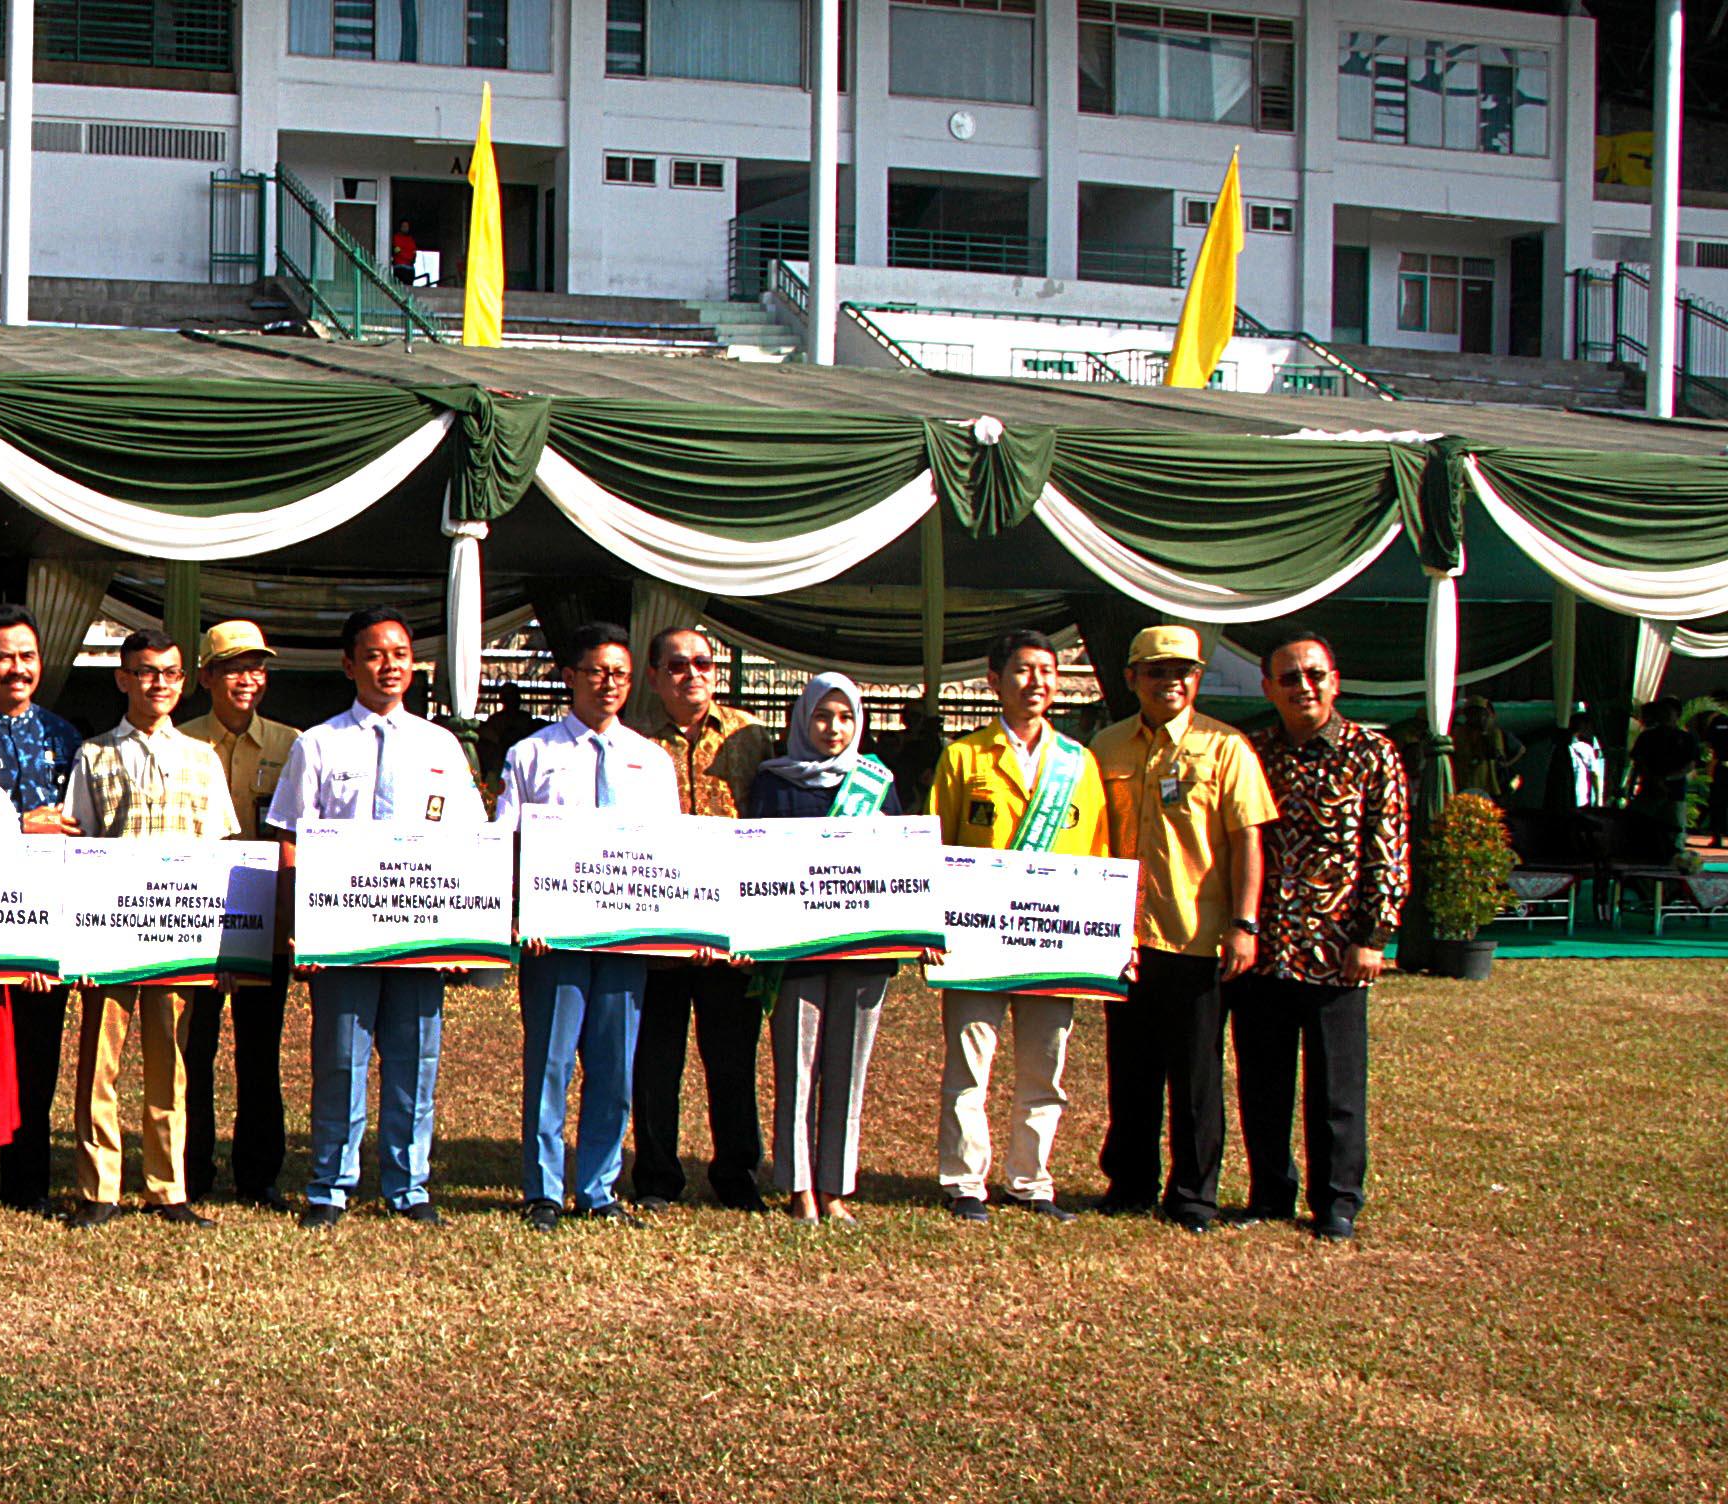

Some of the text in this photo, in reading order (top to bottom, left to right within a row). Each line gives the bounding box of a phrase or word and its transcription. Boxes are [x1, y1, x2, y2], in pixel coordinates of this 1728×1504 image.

[602, 850, 653, 861] BANTUAN
[379, 862, 432, 871] BANTUAN
[574, 861, 681, 879] BEASISWA PRESTASI
[808, 865, 861, 875] BANTUAN
[146, 882, 198, 891] BANTUAN
[350, 876, 460, 889] BEASISWA PRESTASI
[533, 876, 720, 902] SISWA SEKOLAH MENENGAH ATAS
[739, 878, 931, 897] BEASISWA S-1 PETROKIMIA GRESIK
[117, 896, 226, 909] BEASISWA PRESTASI
[308, 893, 501, 910] SISWA SEKOLAH MENENGAH KEJURUAN
[595, 900, 660, 913] TAHUN 2018
[803, 900, 870, 910] TAHUN 2018
[1010, 901, 1060, 913] BANTUAN
[75, 913, 264, 930] SISWA SEKOLAH MENENGAH PERTAMA
[372, 914, 439, 924] TAHUN 2018
[945, 911, 1121, 938] BEASISWA S-1 PETROKIMIA GRESIK
[137, 933, 202, 943] TAHUN 2018
[1001, 935, 1063, 949] TAHUN 2018
